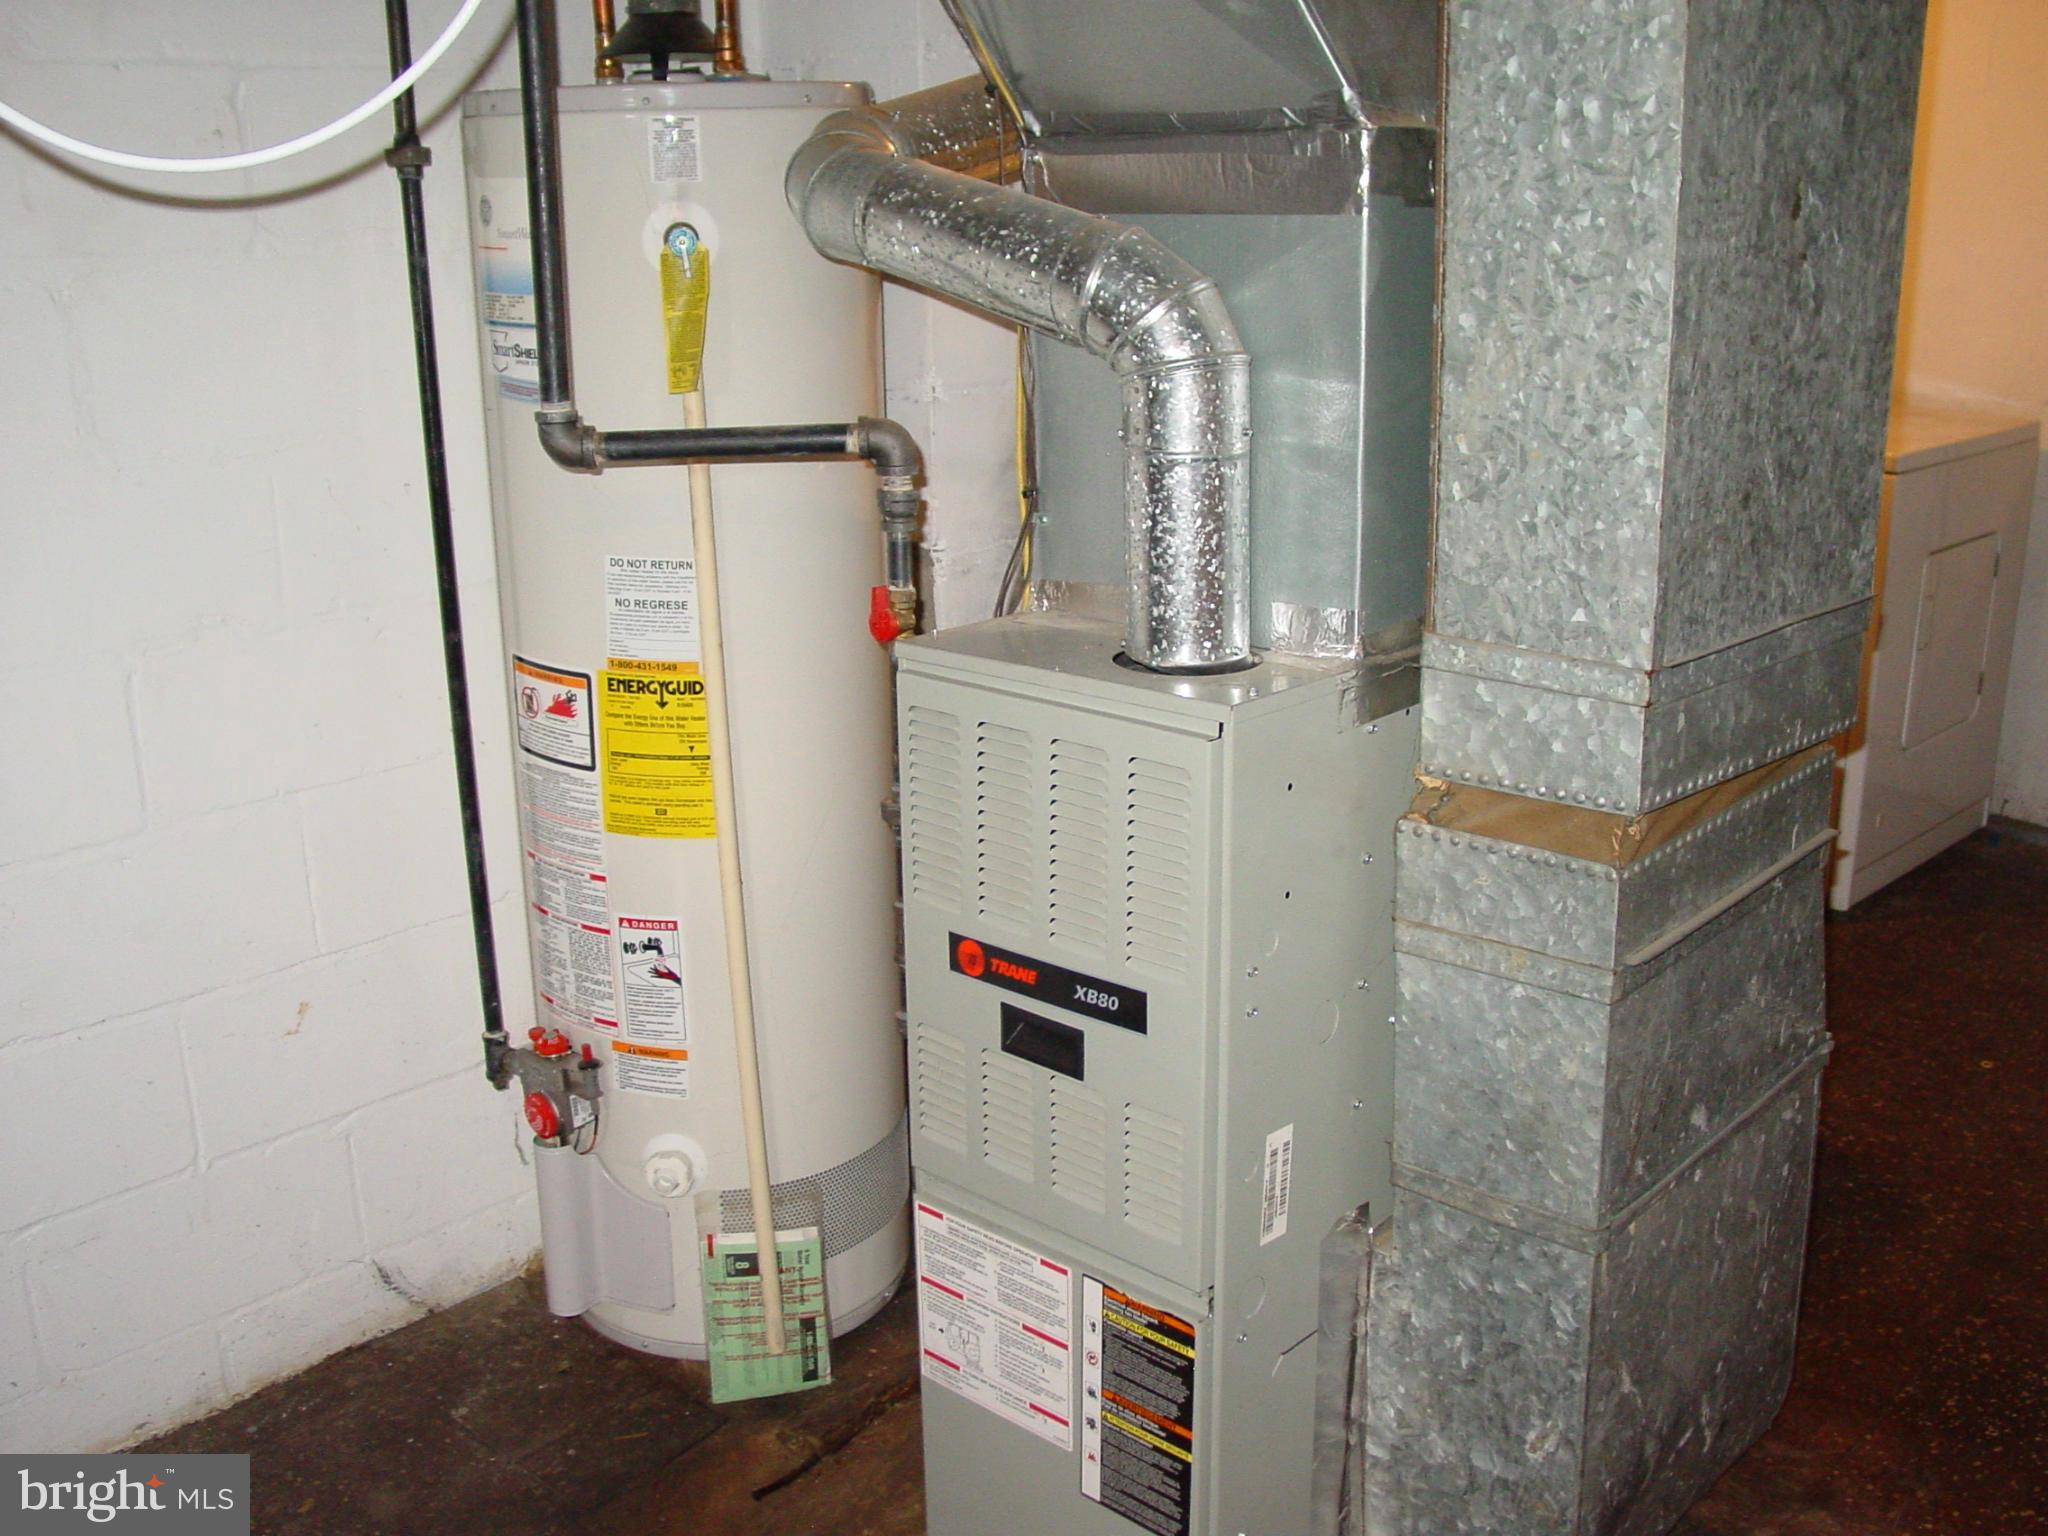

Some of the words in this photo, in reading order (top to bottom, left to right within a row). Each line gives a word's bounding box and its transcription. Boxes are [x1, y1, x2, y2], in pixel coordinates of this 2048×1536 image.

[609, 557, 624, 567] DO
[627, 558, 648, 569] NOT
[650, 560, 693, 570] RETURN
[615, 598, 631, 608] NO
[634, 599, 688, 610] REGRESE
[607, 677, 704, 695] ENERGYGUID
[632, 920, 674, 929] DANGER
[991, 958, 1038, 984] TRANE
[1074, 984, 1119, 1011] XB80
